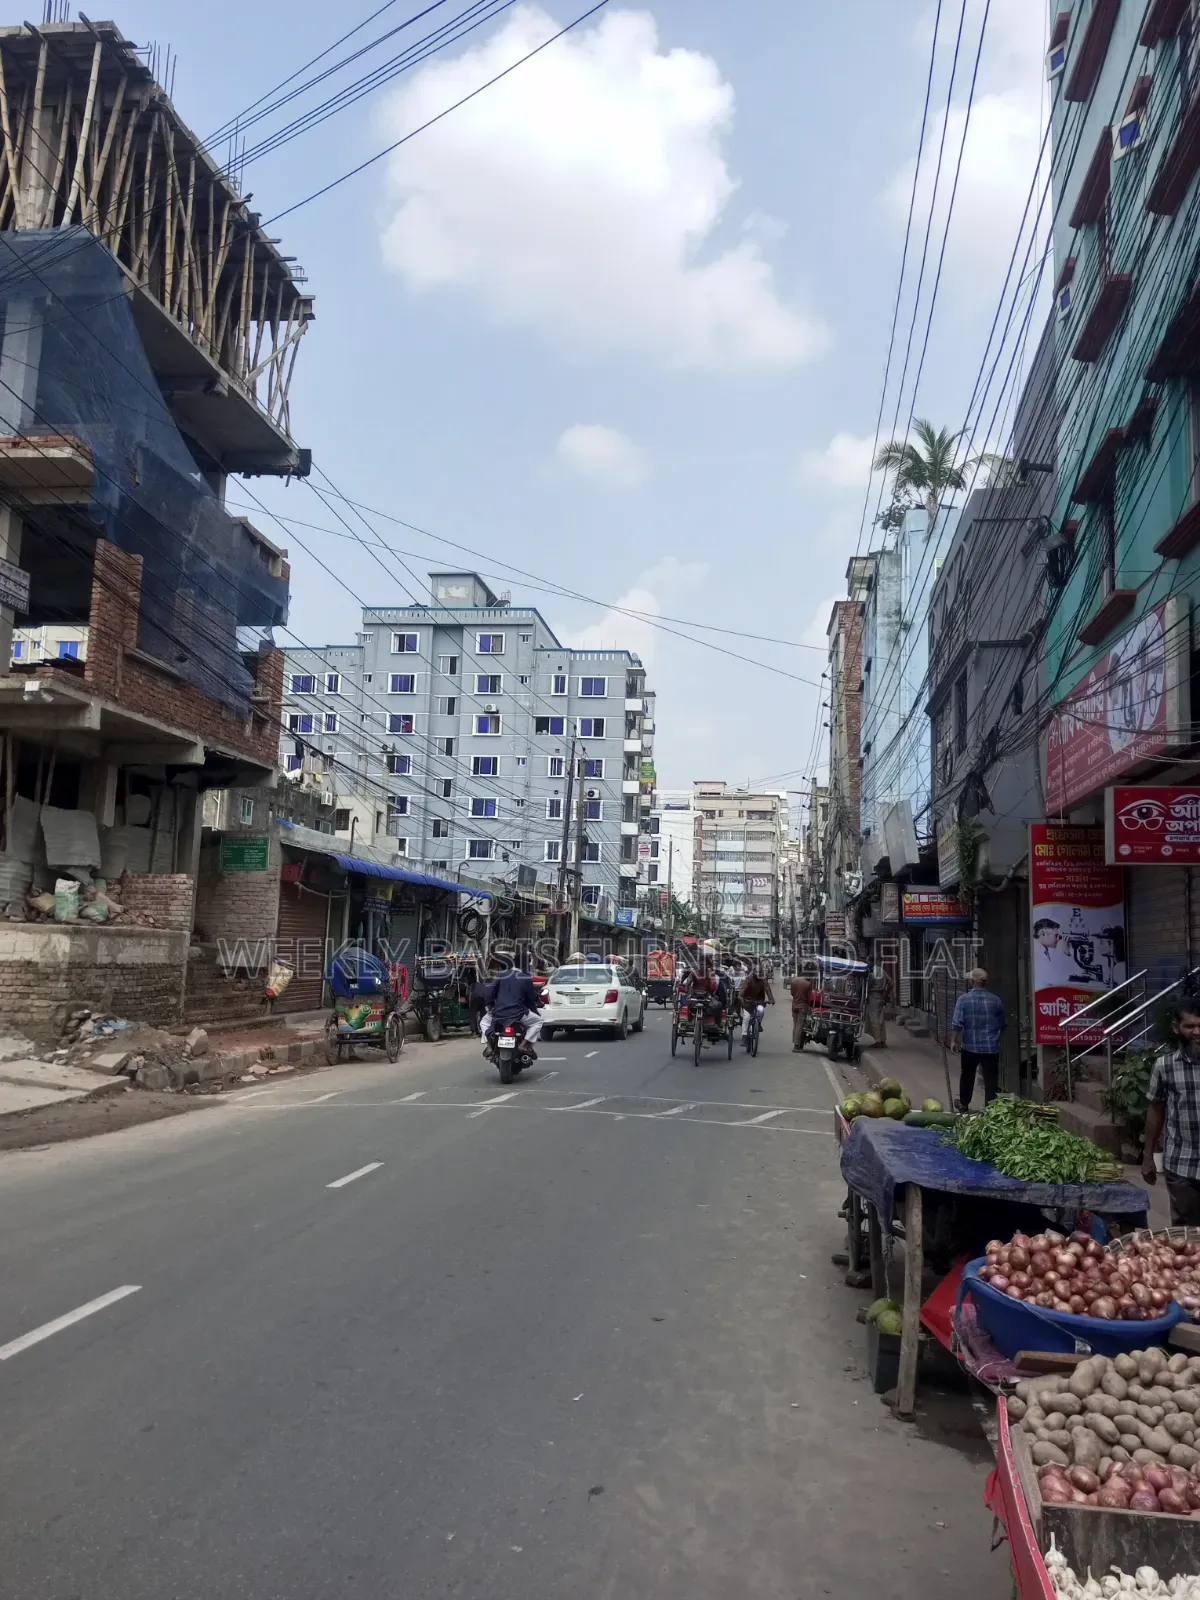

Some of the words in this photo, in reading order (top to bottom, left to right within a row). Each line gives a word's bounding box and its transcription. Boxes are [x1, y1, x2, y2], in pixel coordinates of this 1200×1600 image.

[1034, 844, 1054, 857] মোঃ
[1065, 873, 1089, 882] সার্জন
[1072, 908, 1082, 917] E
